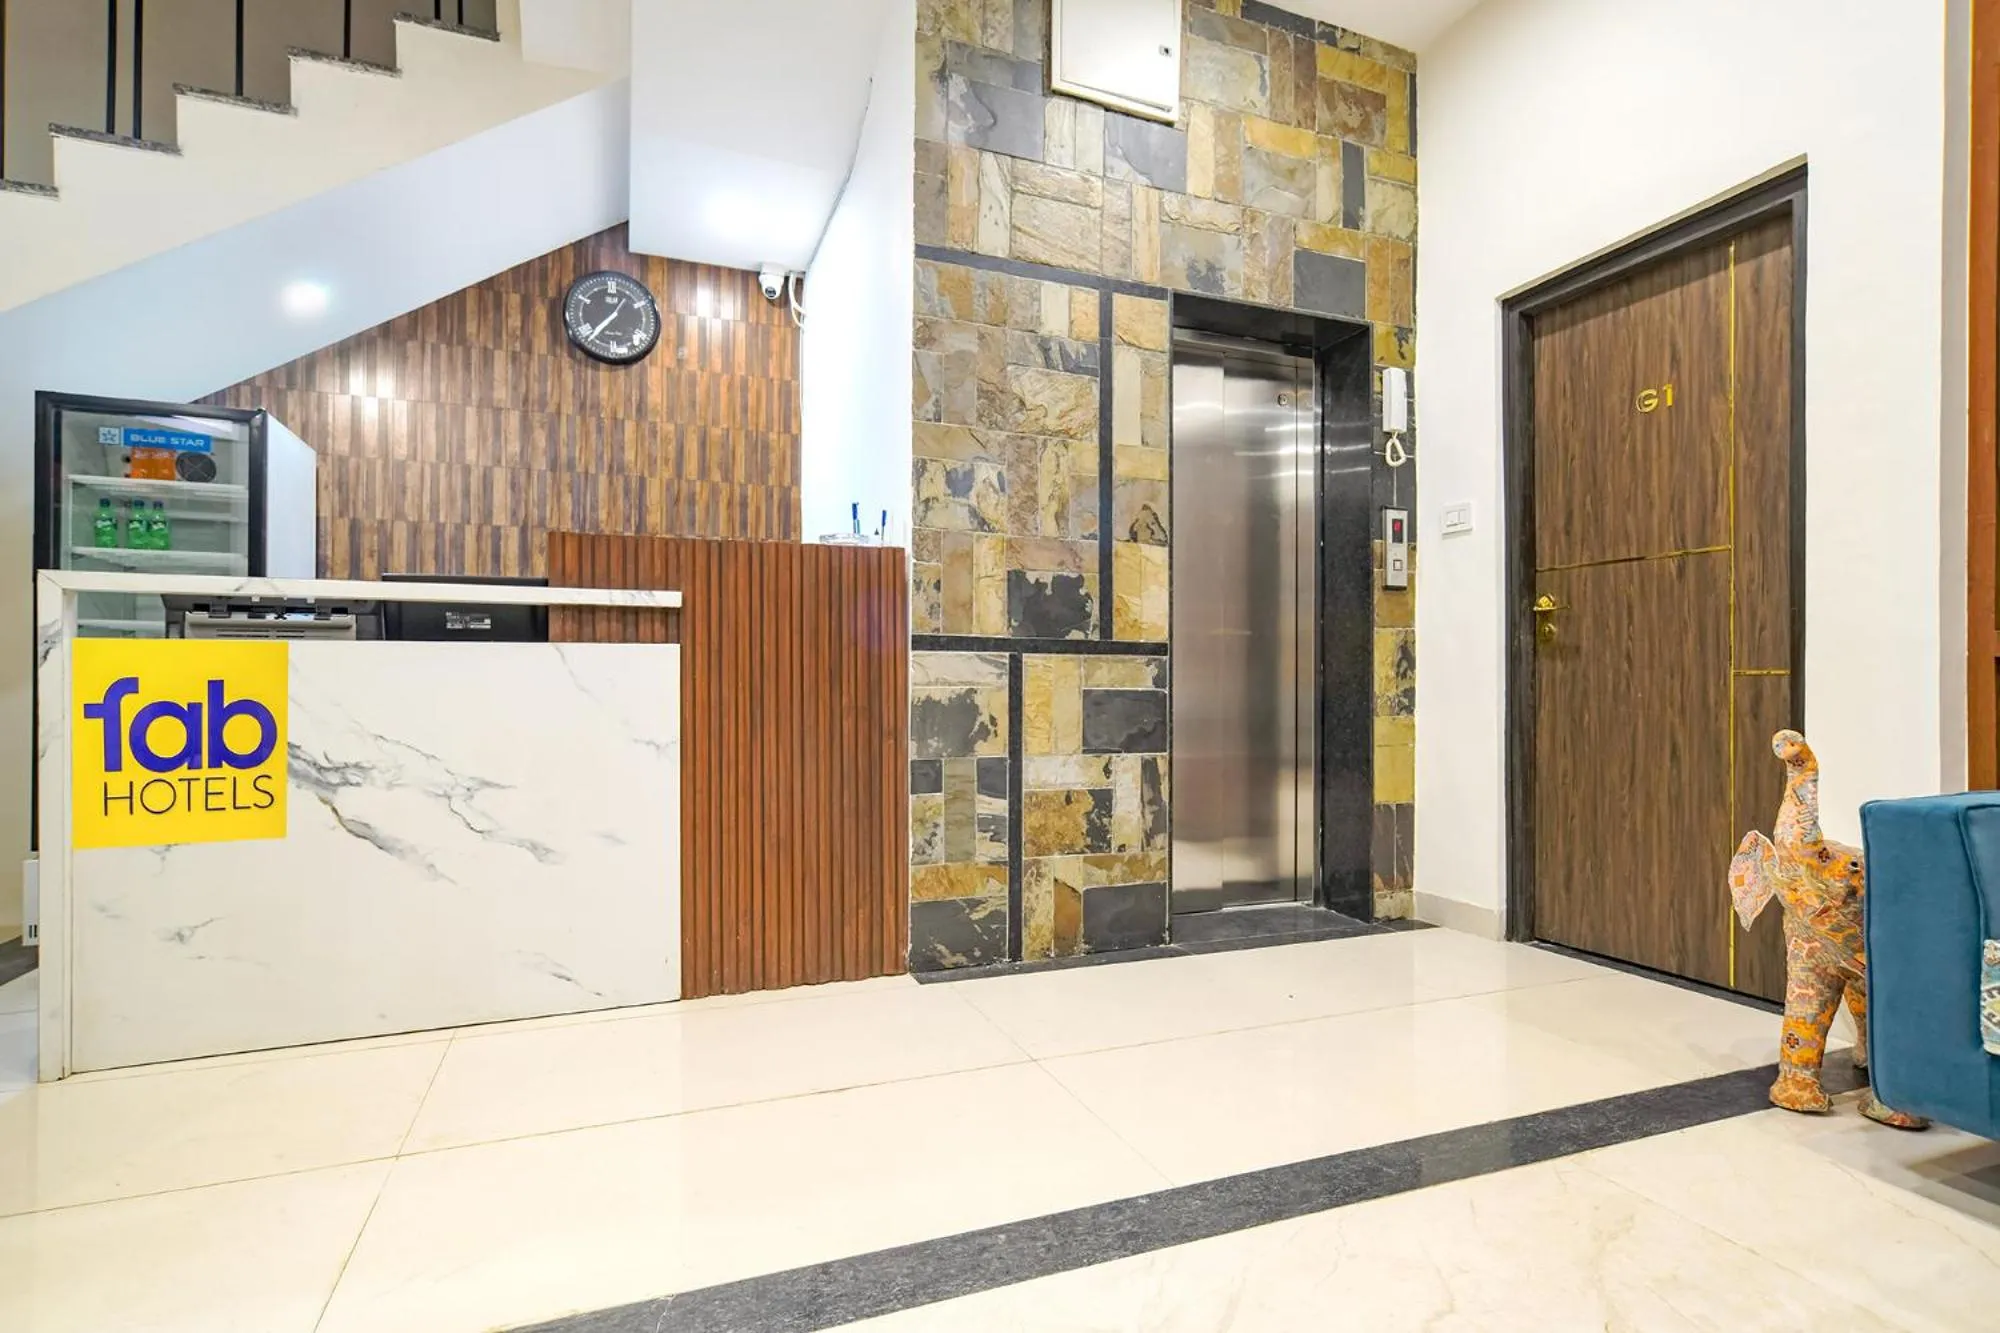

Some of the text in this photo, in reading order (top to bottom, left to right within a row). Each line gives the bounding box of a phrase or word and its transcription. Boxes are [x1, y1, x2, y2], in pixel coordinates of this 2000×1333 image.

[1636, 384, 1674, 413] G1
[129, 433, 205, 447] BLUE STAR
[84, 677, 278, 773] fab
[103, 774, 275, 816] HOTELS
